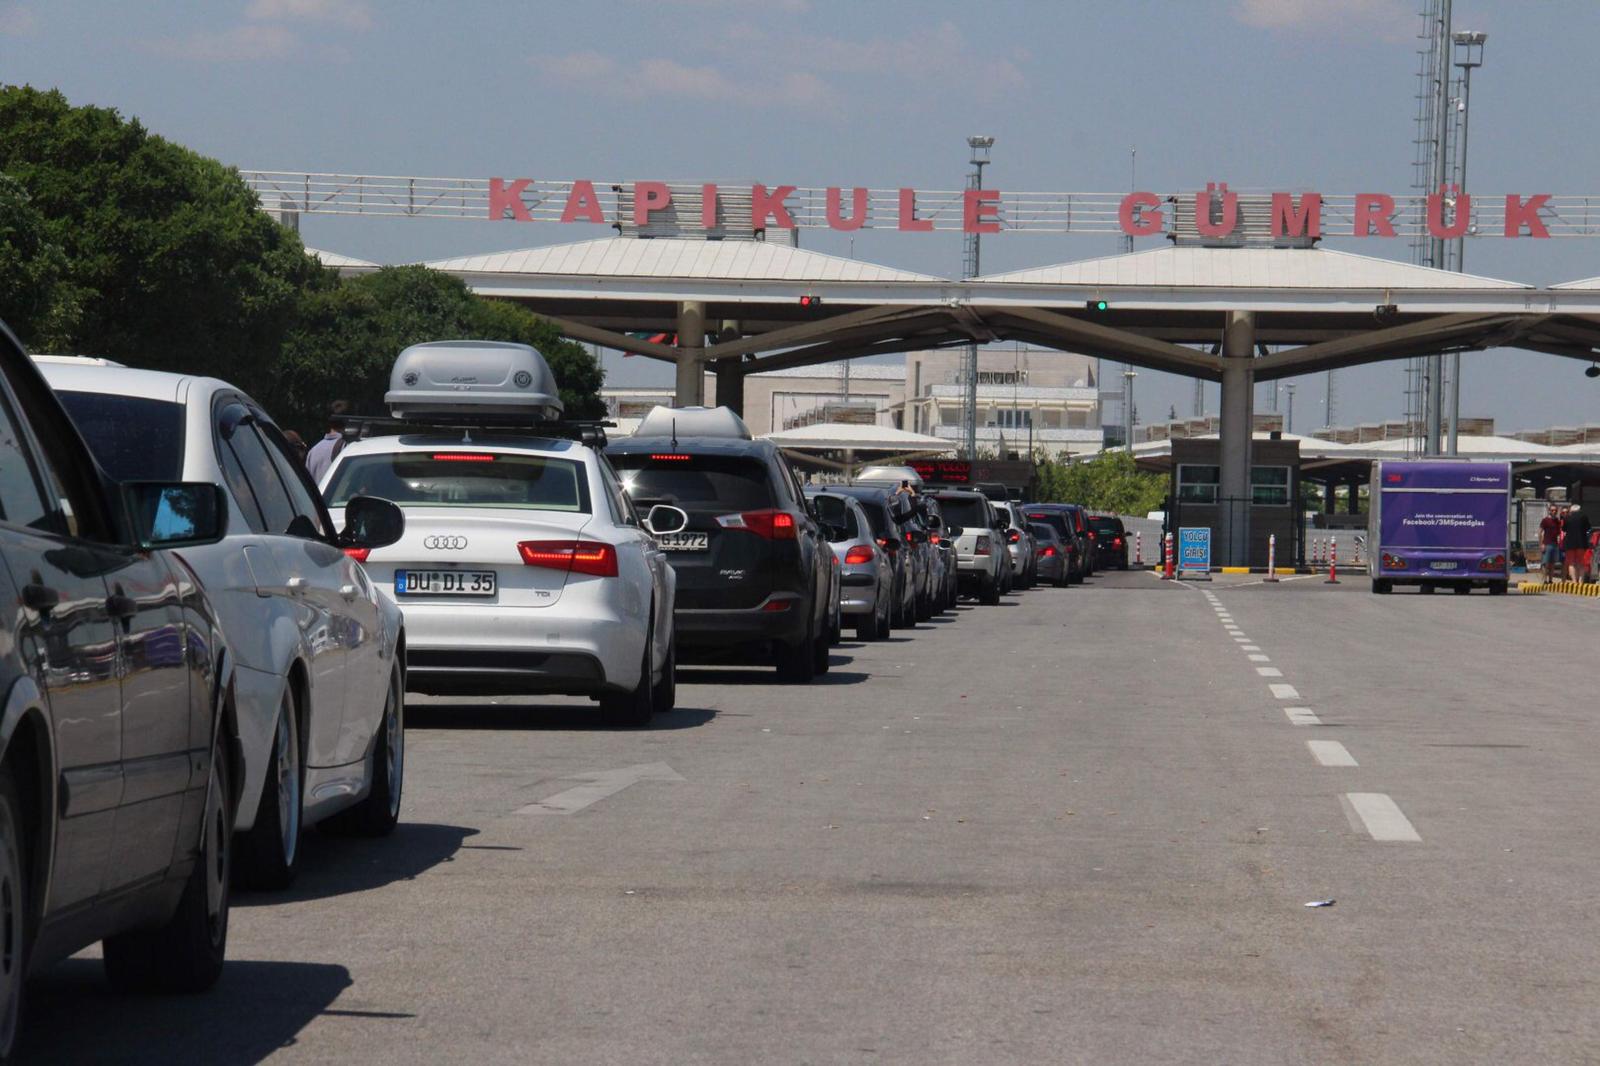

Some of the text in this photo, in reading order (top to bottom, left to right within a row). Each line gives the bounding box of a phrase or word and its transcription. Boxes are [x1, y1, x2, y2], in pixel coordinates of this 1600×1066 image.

[488, 177, 1552, 240] KAPIKULE GÜMRÜK
[1402, 518, 1485, 527] Facebook/3MSpeedglas
[1184, 531, 1208, 542] YOLCU
[407, 573, 493, 591] DU DI 35
